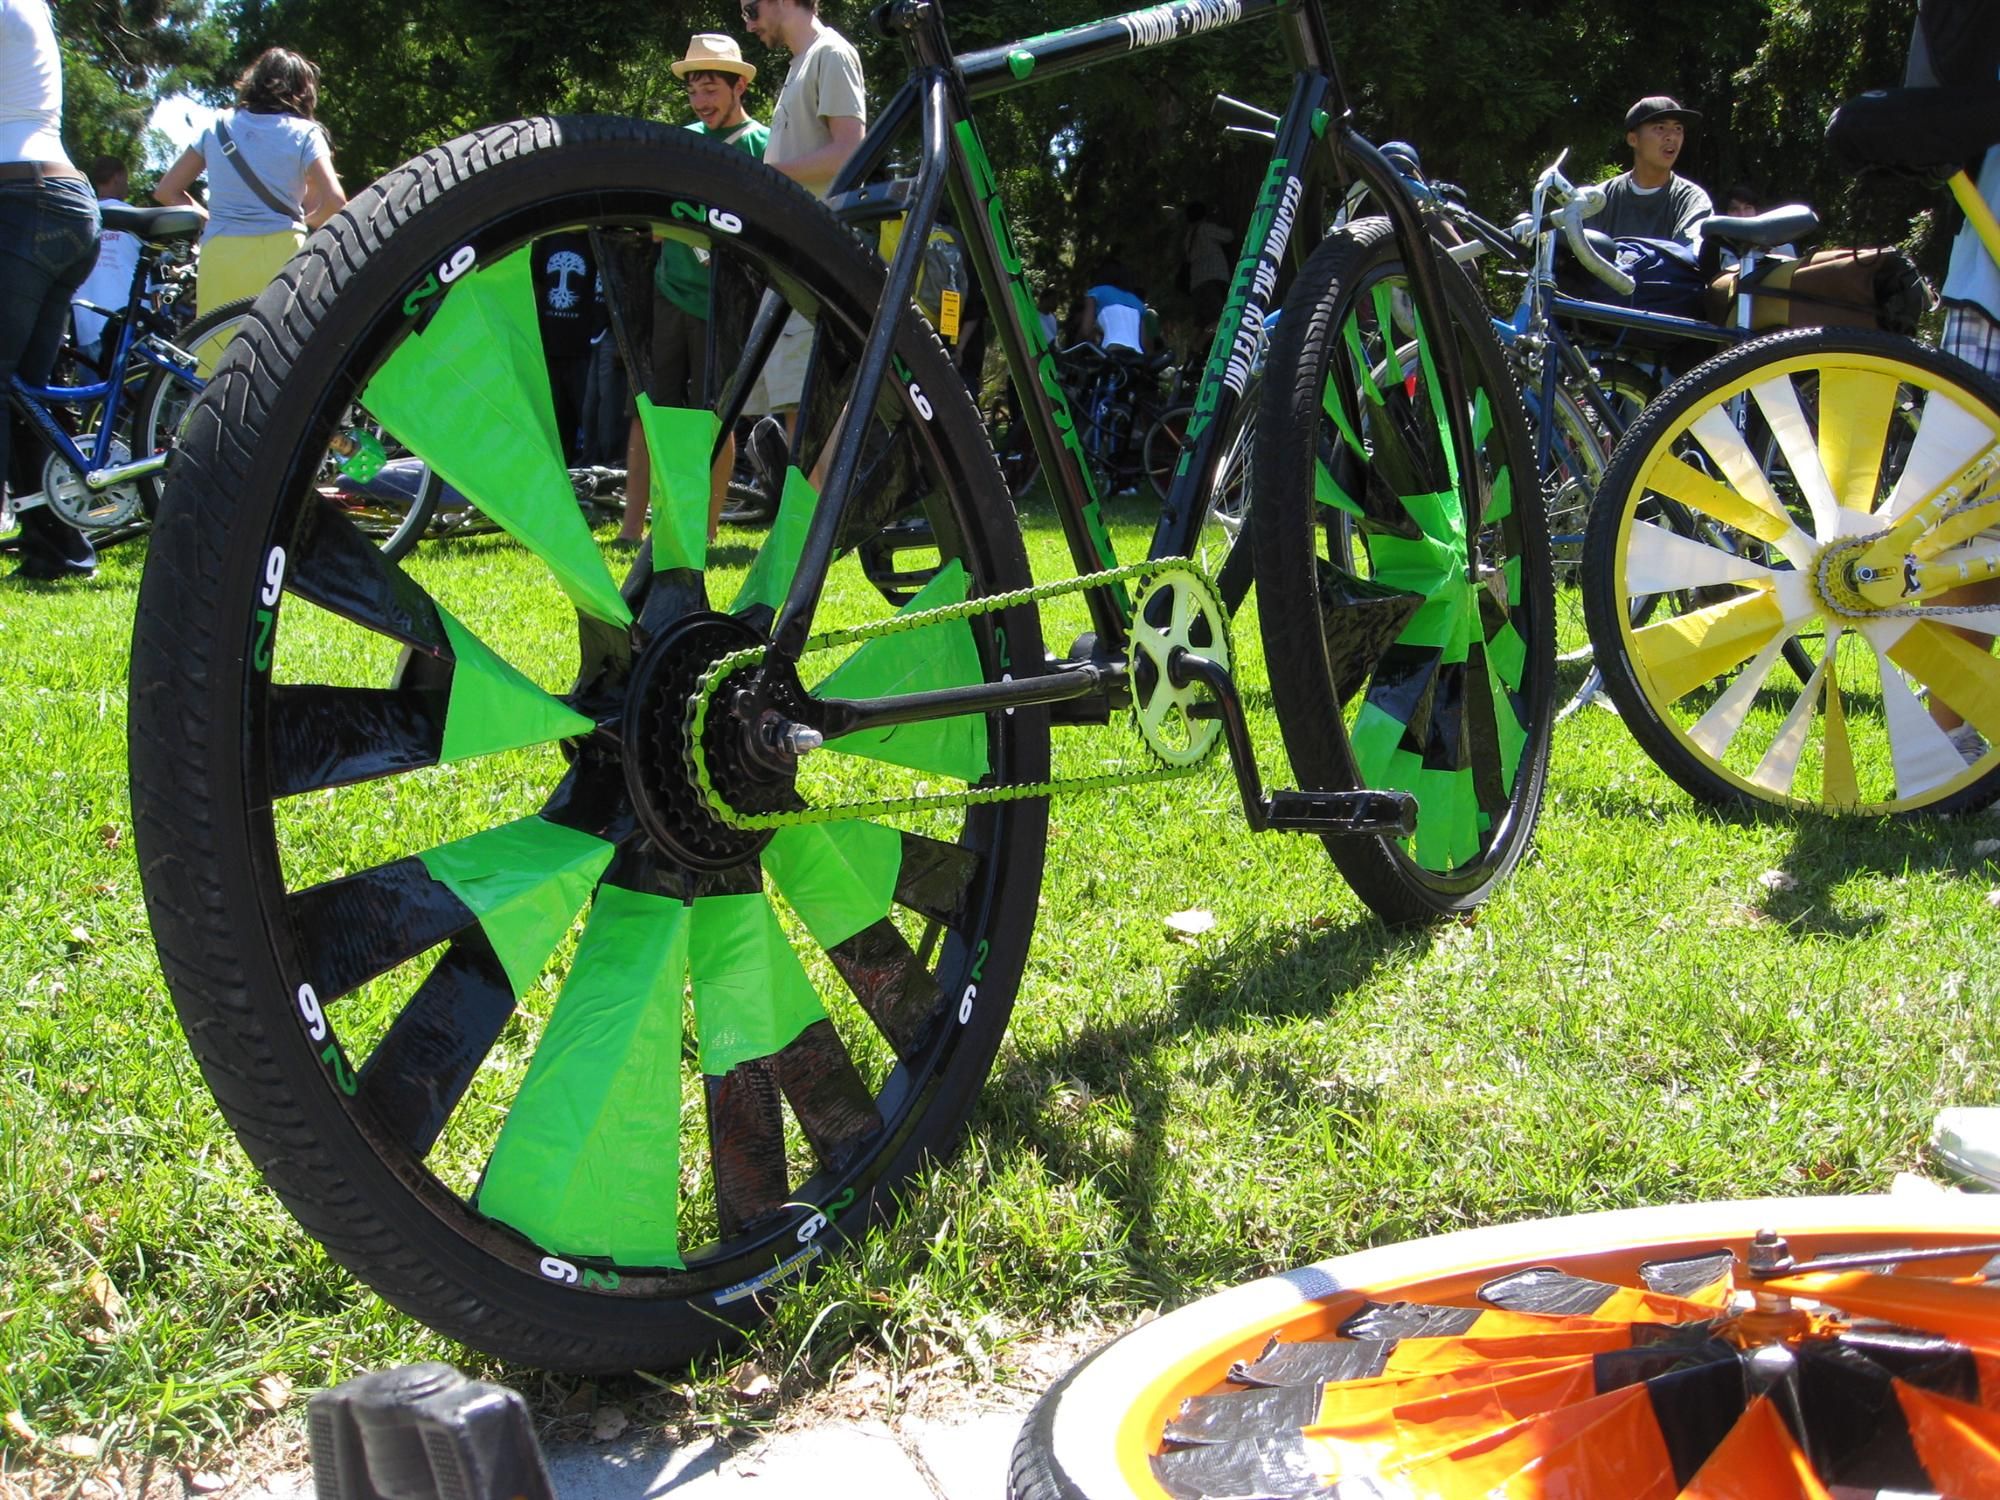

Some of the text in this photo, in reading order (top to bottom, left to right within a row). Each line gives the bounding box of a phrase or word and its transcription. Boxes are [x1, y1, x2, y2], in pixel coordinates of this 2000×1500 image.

[671, 200, 743, 235] 26
[403, 245, 476, 316] 26
[1177, 158, 1288, 476] ENERGY
[1223, 175, 1303, 399] UNLEASH THE MONSTER
[253, 545, 286, 673] 26
[959, 939, 989, 1025] 26
[298, 982, 358, 1097] 26
[797, 1187, 855, 1242] 26
[541, 1257, 620, 1290] 26
